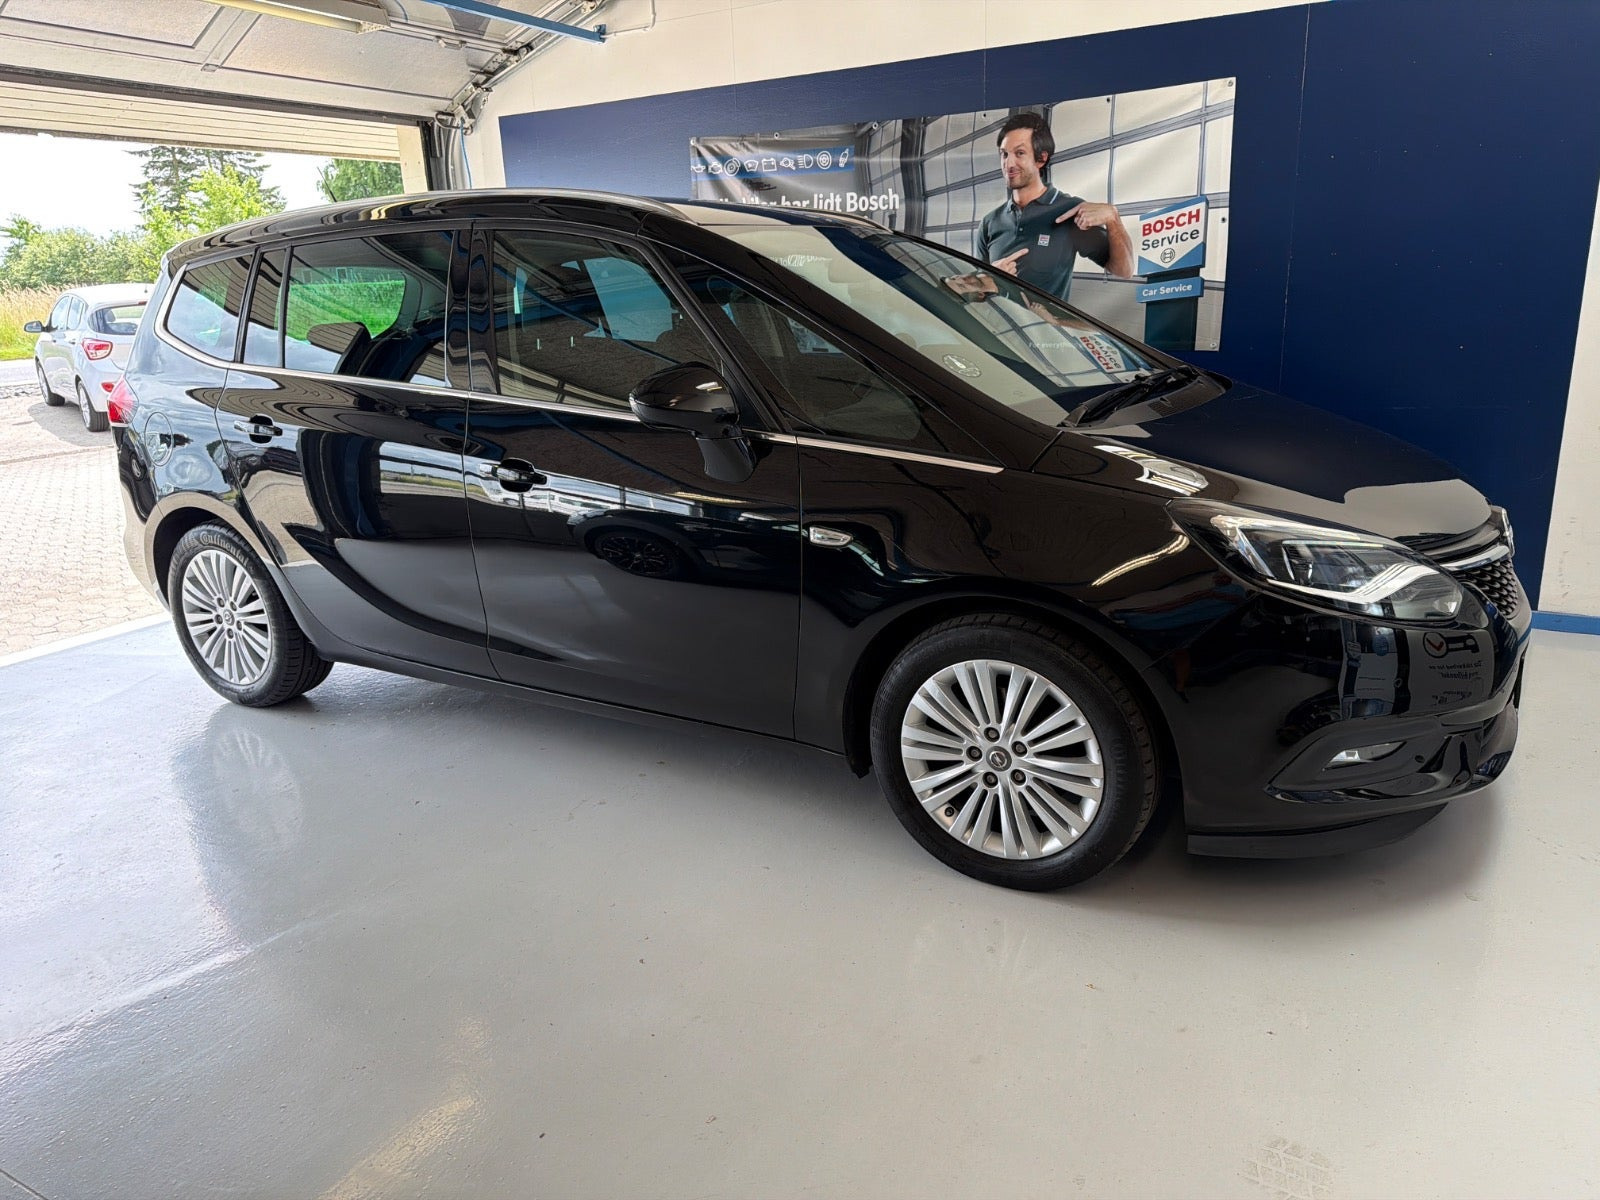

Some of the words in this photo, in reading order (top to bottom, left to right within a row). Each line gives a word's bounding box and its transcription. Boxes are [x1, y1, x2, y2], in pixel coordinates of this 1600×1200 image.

[813, 192, 842, 212] lidt
[846, 187, 900, 213] Bosch
[1142, 208, 1201, 237] BOSCH
[1141, 229, 1200, 251] Service
[1142, 289, 1157, 297] Car
[1160, 283, 1193, 295] Service
